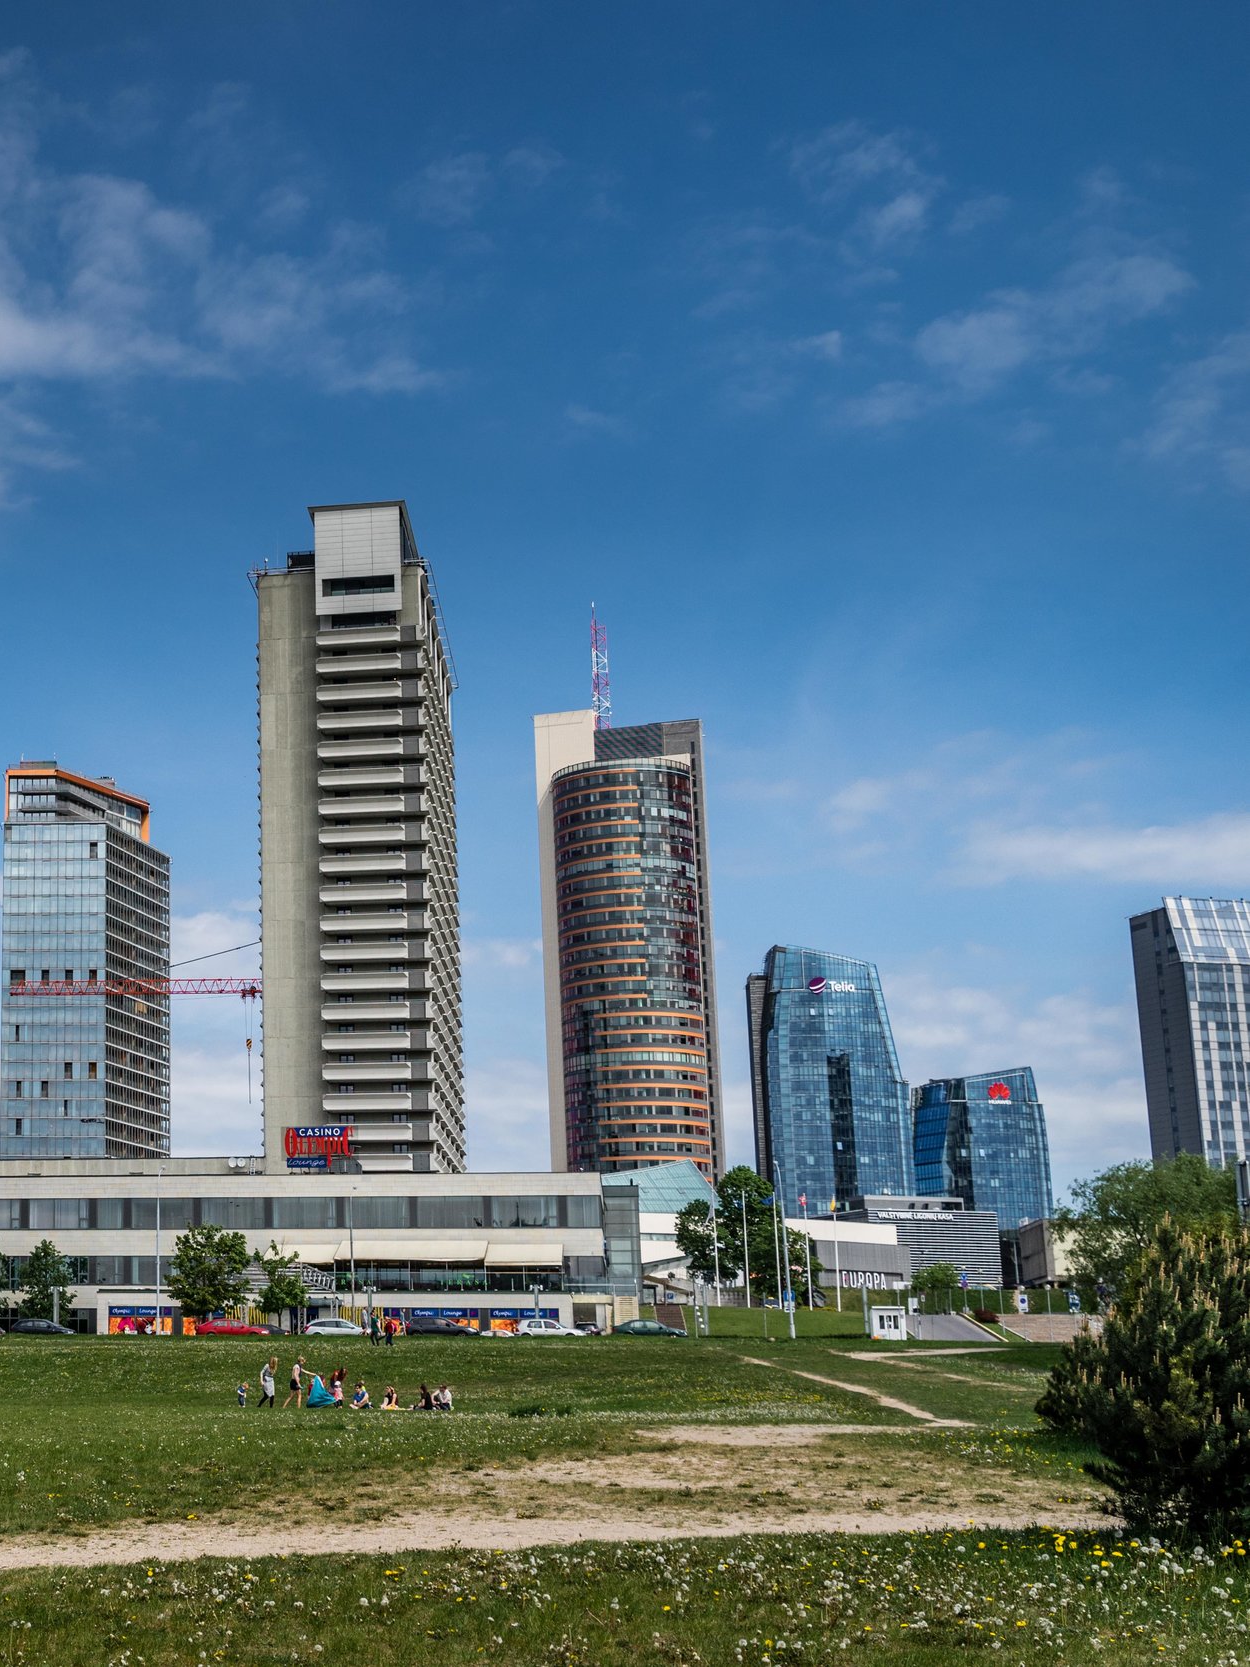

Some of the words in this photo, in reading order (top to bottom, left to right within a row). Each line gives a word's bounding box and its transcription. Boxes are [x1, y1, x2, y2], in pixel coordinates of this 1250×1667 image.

[828, 981, 856, 992] Telia
[299, 1128, 341, 1137] CASINO
[287, 1159, 326, 1167] Lounge
[841, 1270, 887, 1290] EUROPA
[443, 1309, 463, 1317] Lounge
